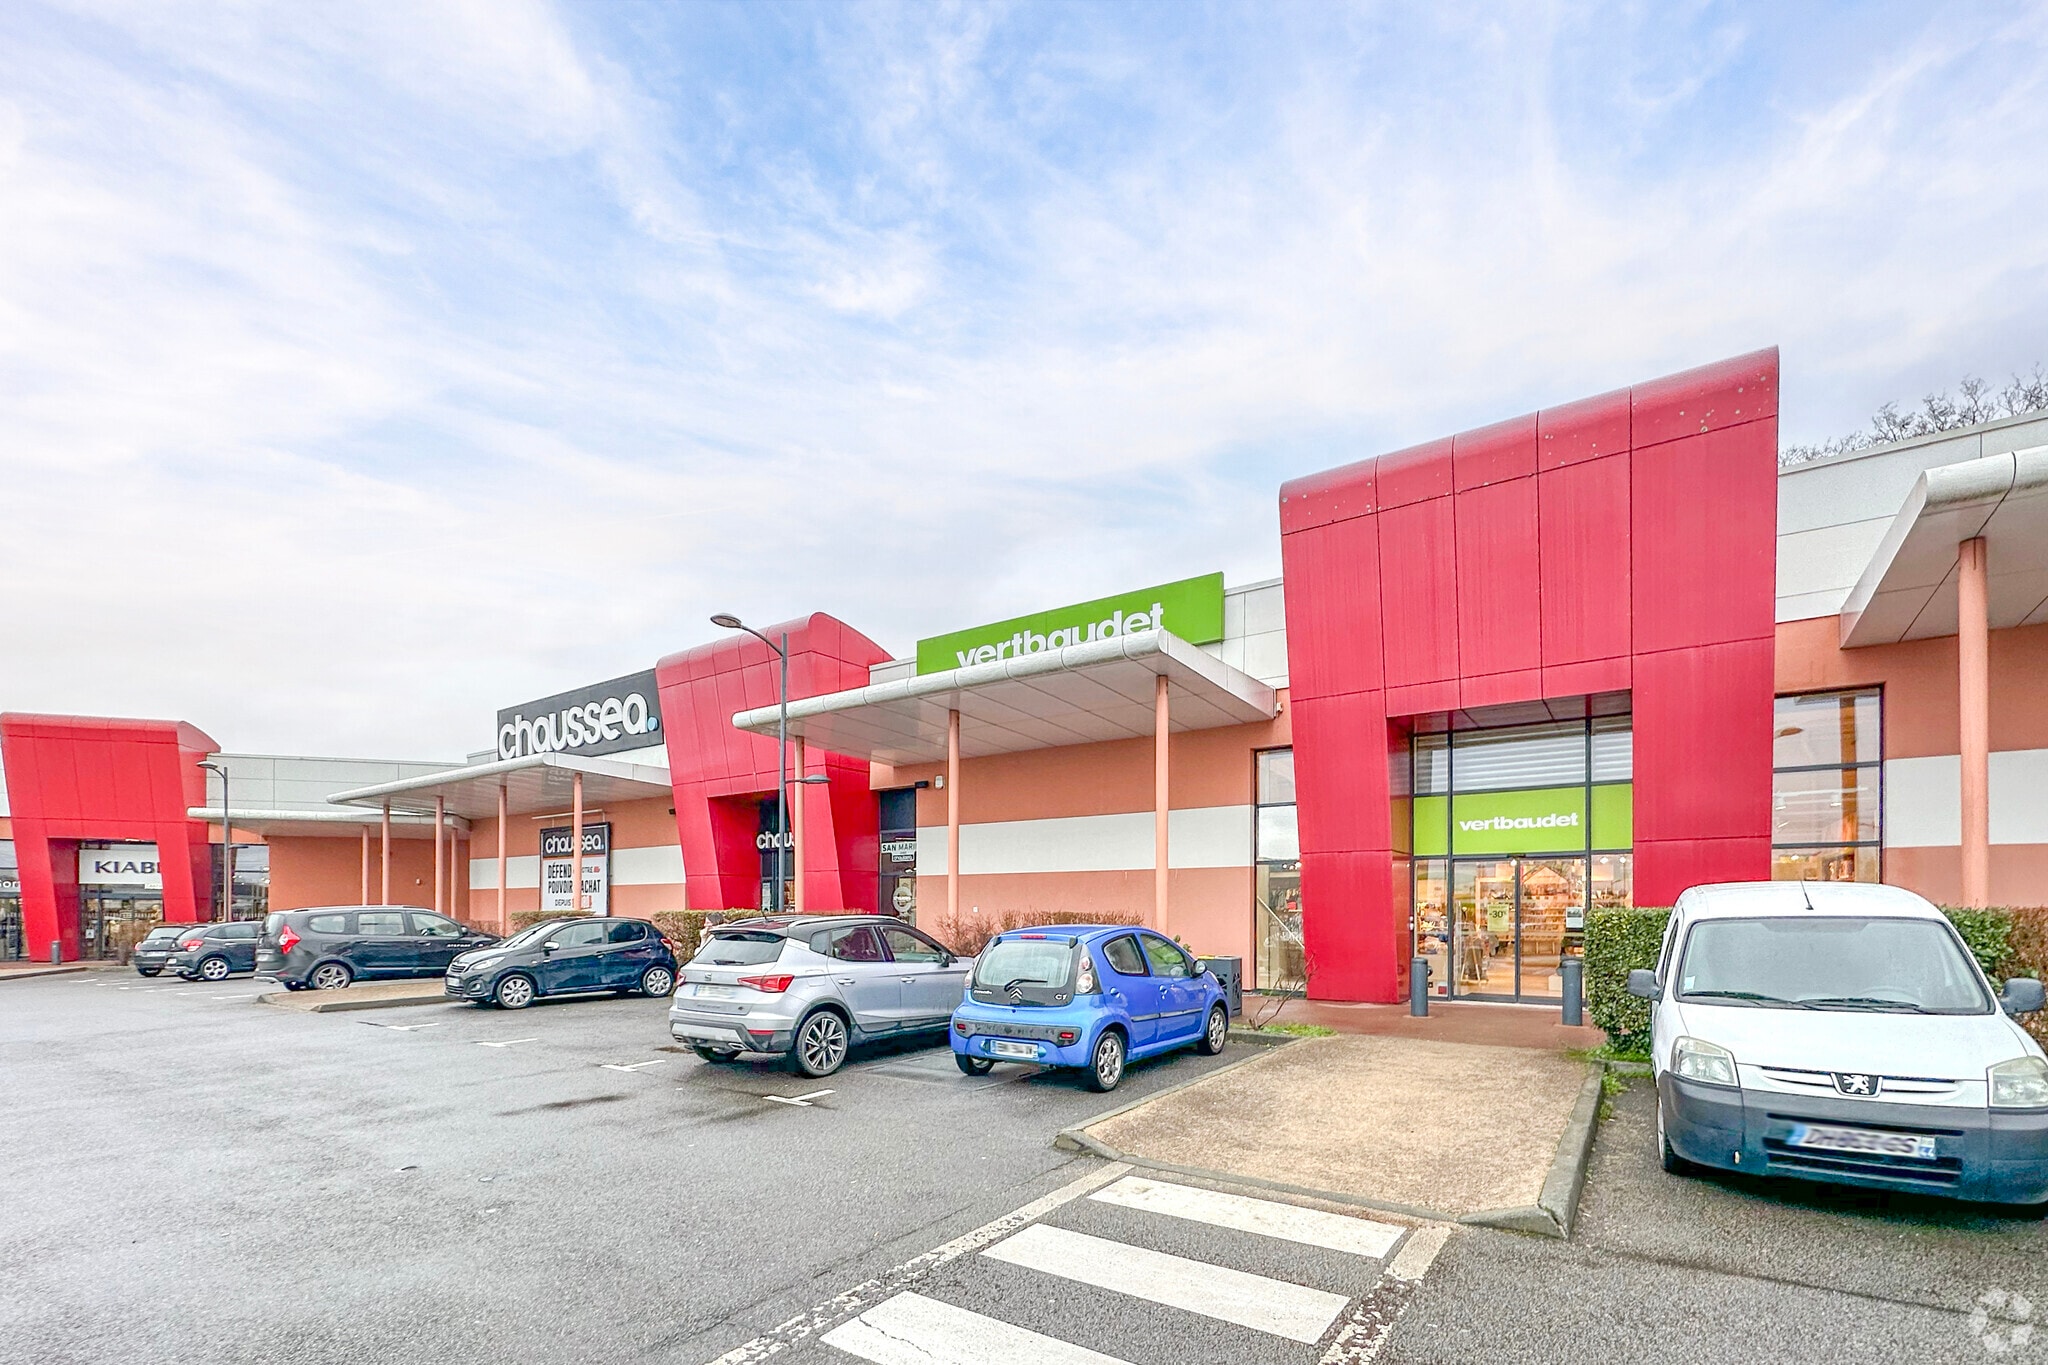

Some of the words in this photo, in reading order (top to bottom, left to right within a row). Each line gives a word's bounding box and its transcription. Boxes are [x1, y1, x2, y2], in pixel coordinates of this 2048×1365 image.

[956, 602, 1164, 668] vertbaudet
[1459, 812, 1578, 831] vertbaudet
[756, 831, 795, 849] chau
[882, 844, 897, 852] SAN
